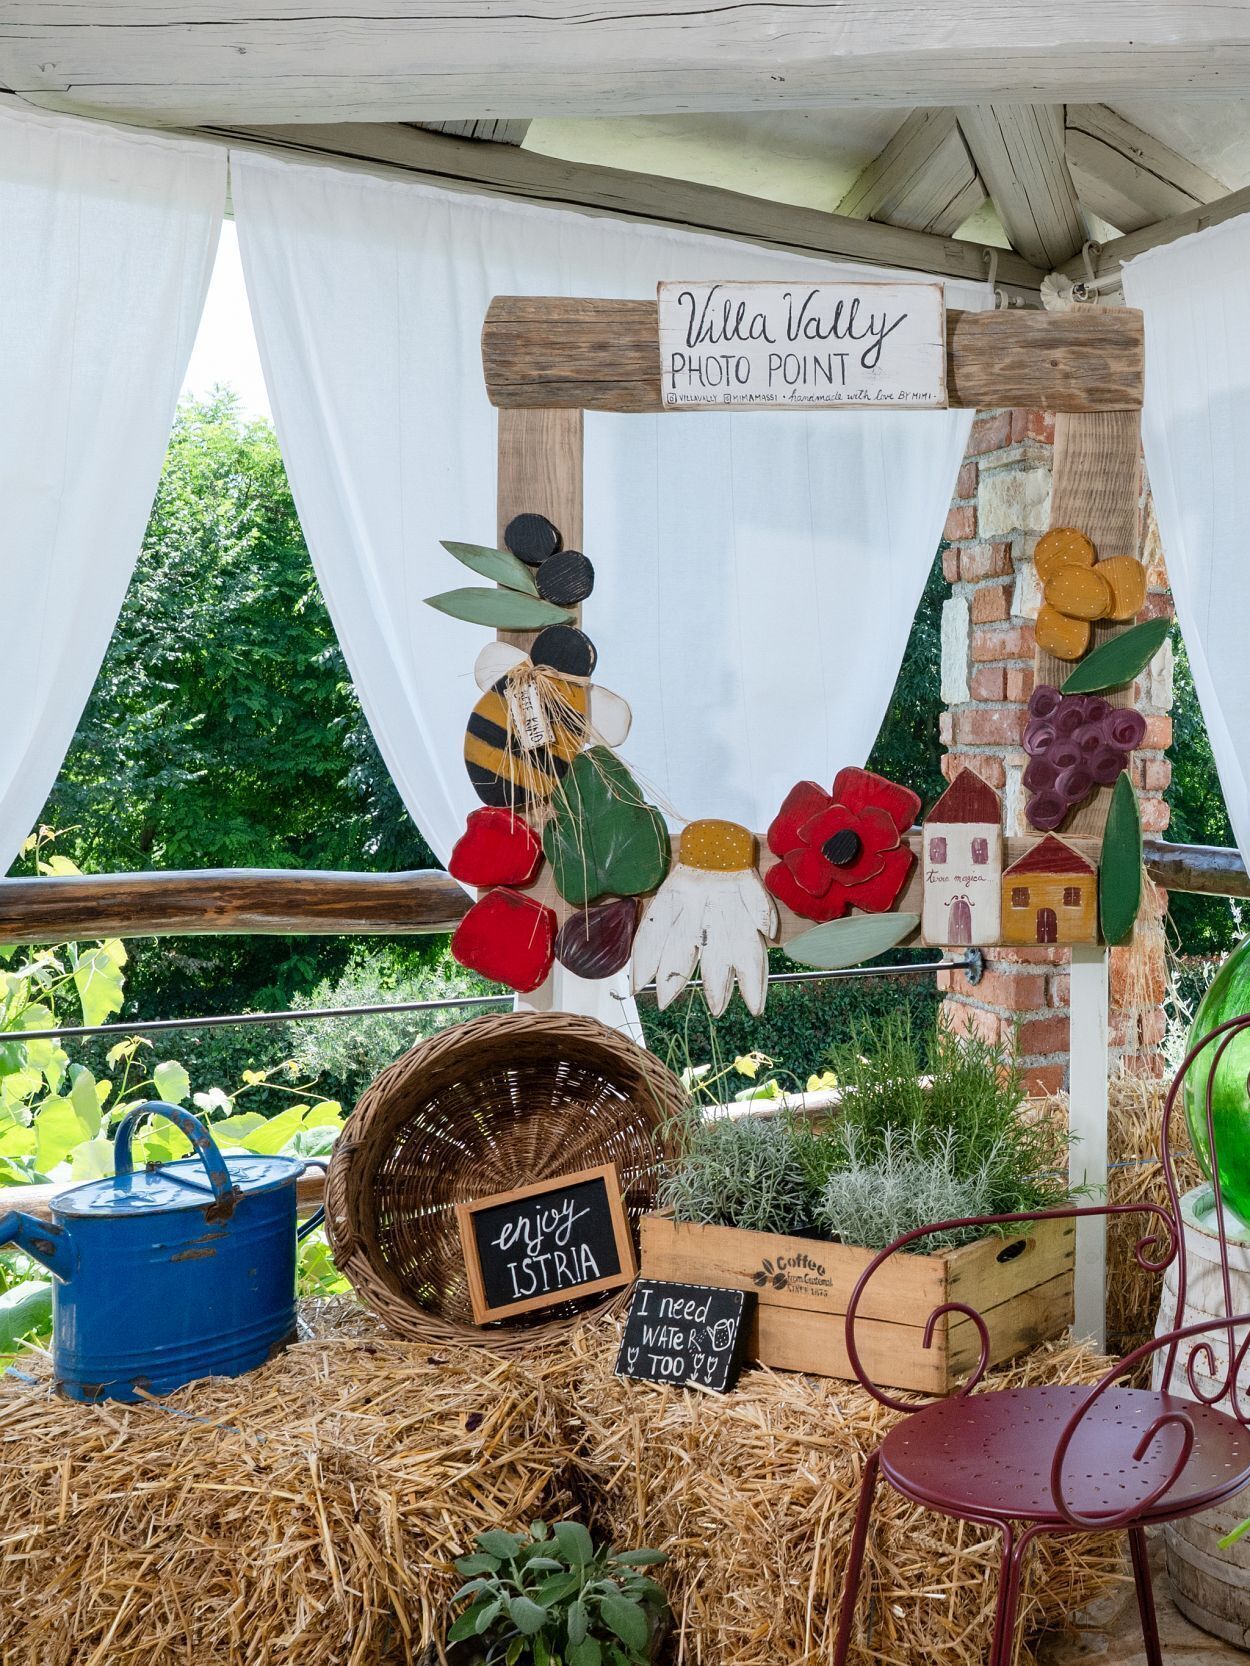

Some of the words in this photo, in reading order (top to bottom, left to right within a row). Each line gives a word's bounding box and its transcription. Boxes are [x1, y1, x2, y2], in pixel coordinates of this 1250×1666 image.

[678, 285, 776, 347] Villa
[783, 289, 908, 369] Vally
[671, 352, 750, 388] PHOTO
[769, 353, 849, 387] POINT
[788, 388, 843, 402] handmade
[847, 389, 871, 401] with
[874, 389, 895, 401] love
[897, 390, 911, 401] BY
[525, 717, 544, 743] KIND
[491, 1199, 590, 1256] enjoy
[507, 1244, 600, 1298] ISTRIA
[776, 1253, 826, 1276] Coffee
[637, 1289, 653, 1316] I
[659, 1296, 712, 1323] need
[648, 1354, 684, 1376] TOO
